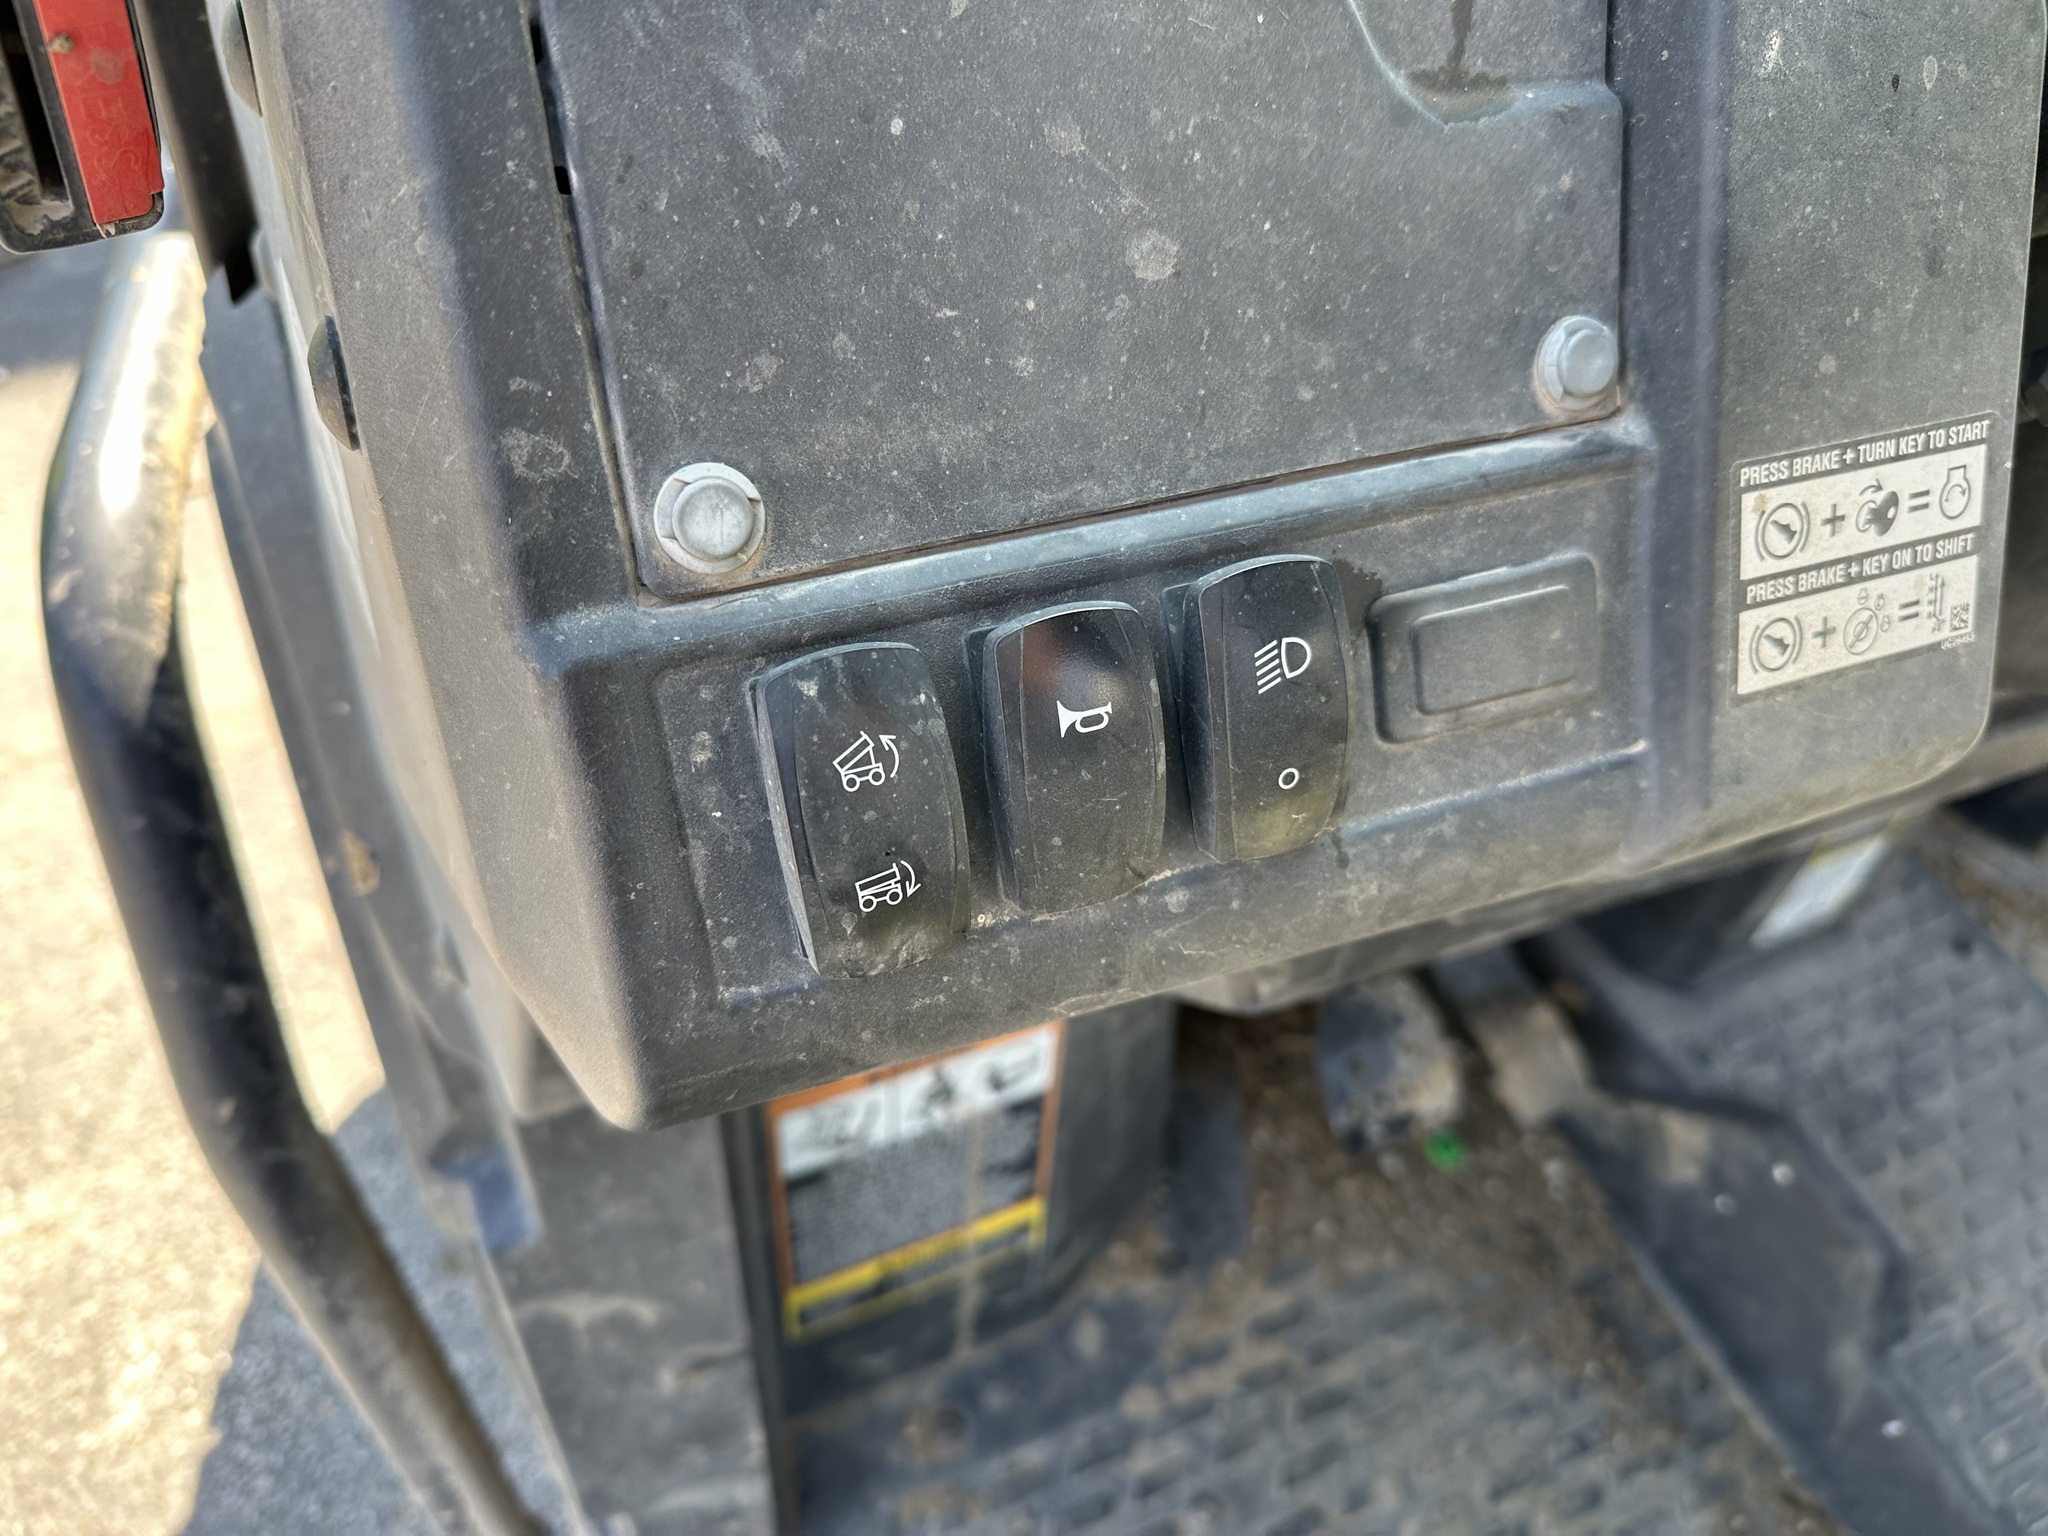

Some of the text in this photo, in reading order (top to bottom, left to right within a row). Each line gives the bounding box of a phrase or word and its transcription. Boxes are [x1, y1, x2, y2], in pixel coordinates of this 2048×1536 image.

[1740, 461, 1789, 487] PRESS
[1792, 450, 1840, 477] BRAKE
[1857, 440, 1896, 464] TURN
[1898, 434, 1927, 456] KEY
[1927, 427, 1946, 449] TO
[1948, 420, 1990, 446] START
[1746, 577, 1794, 605] PRESS
[1798, 565, 1846, 592] BRAKE
[1862, 553, 1890, 576] KEY
[1892, 548, 1912, 569] ON
[1915, 542, 1934, 563] TO
[1935, 533, 1975, 560] SHIFT
